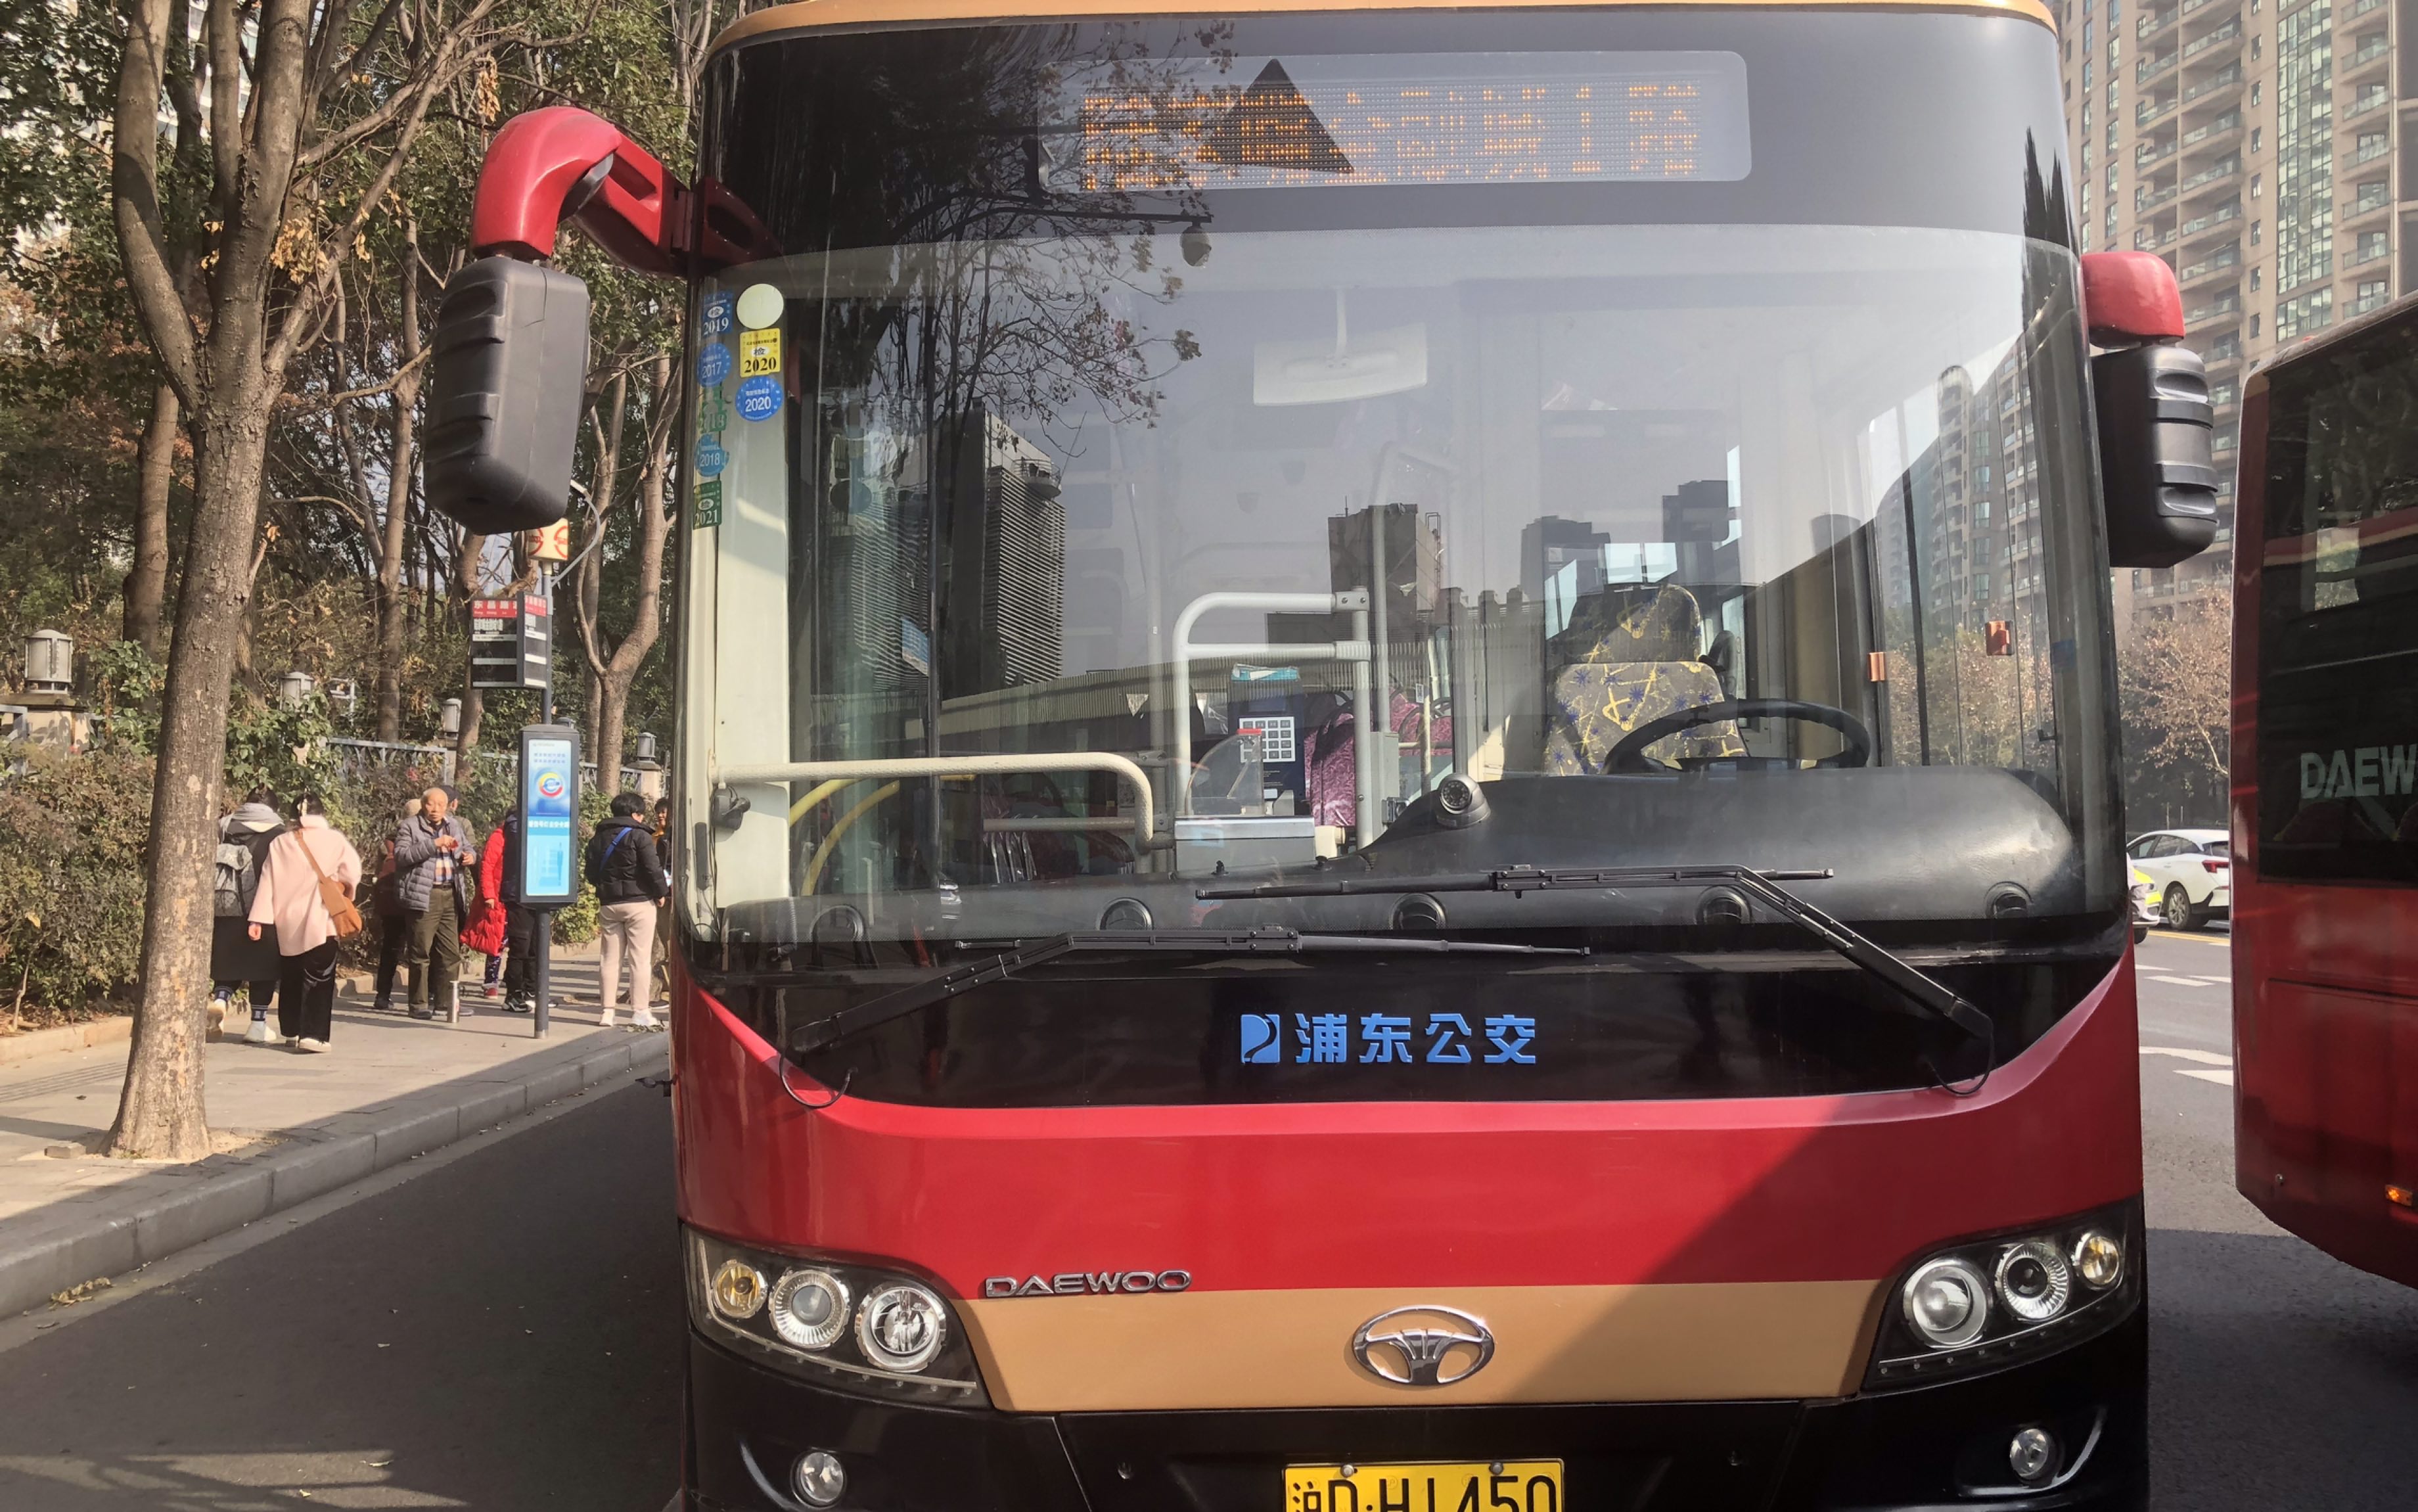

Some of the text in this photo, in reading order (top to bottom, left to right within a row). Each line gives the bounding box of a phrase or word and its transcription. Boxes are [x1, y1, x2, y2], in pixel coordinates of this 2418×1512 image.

[704, 317, 729, 335] 2019
[702, 361, 722, 378] 2017
[744, 357, 777, 373] 2020
[744, 396, 771, 413] 2020
[699, 453, 721, 467] 2018
[695, 509, 718, 529] 2021
[1295, 1013, 1536, 1064] 浦东公交
[986, 1270, 1192, 1298] DAEWOO
